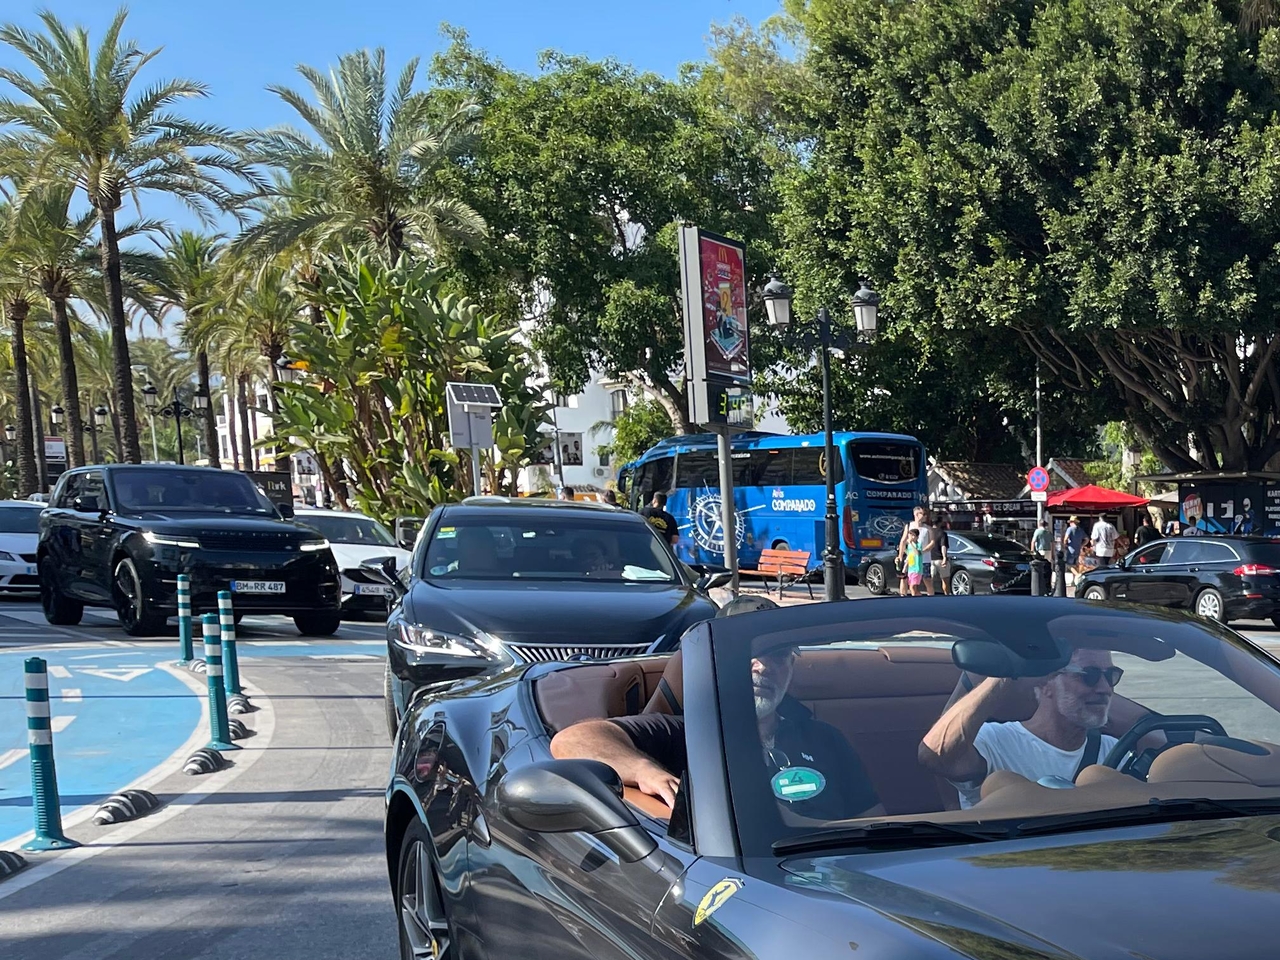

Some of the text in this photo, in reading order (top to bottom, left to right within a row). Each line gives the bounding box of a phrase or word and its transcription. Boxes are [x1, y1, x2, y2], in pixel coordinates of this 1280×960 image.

[845, 491, 859, 500] AC
[866, 490, 912, 499] COMPARADO
[771, 498, 816, 512] COMPARADO
[993, 503, 1002, 511] ICE
[1003, 503, 1021, 511] CREAM
[236, 582, 284, 591] BM RR 487
